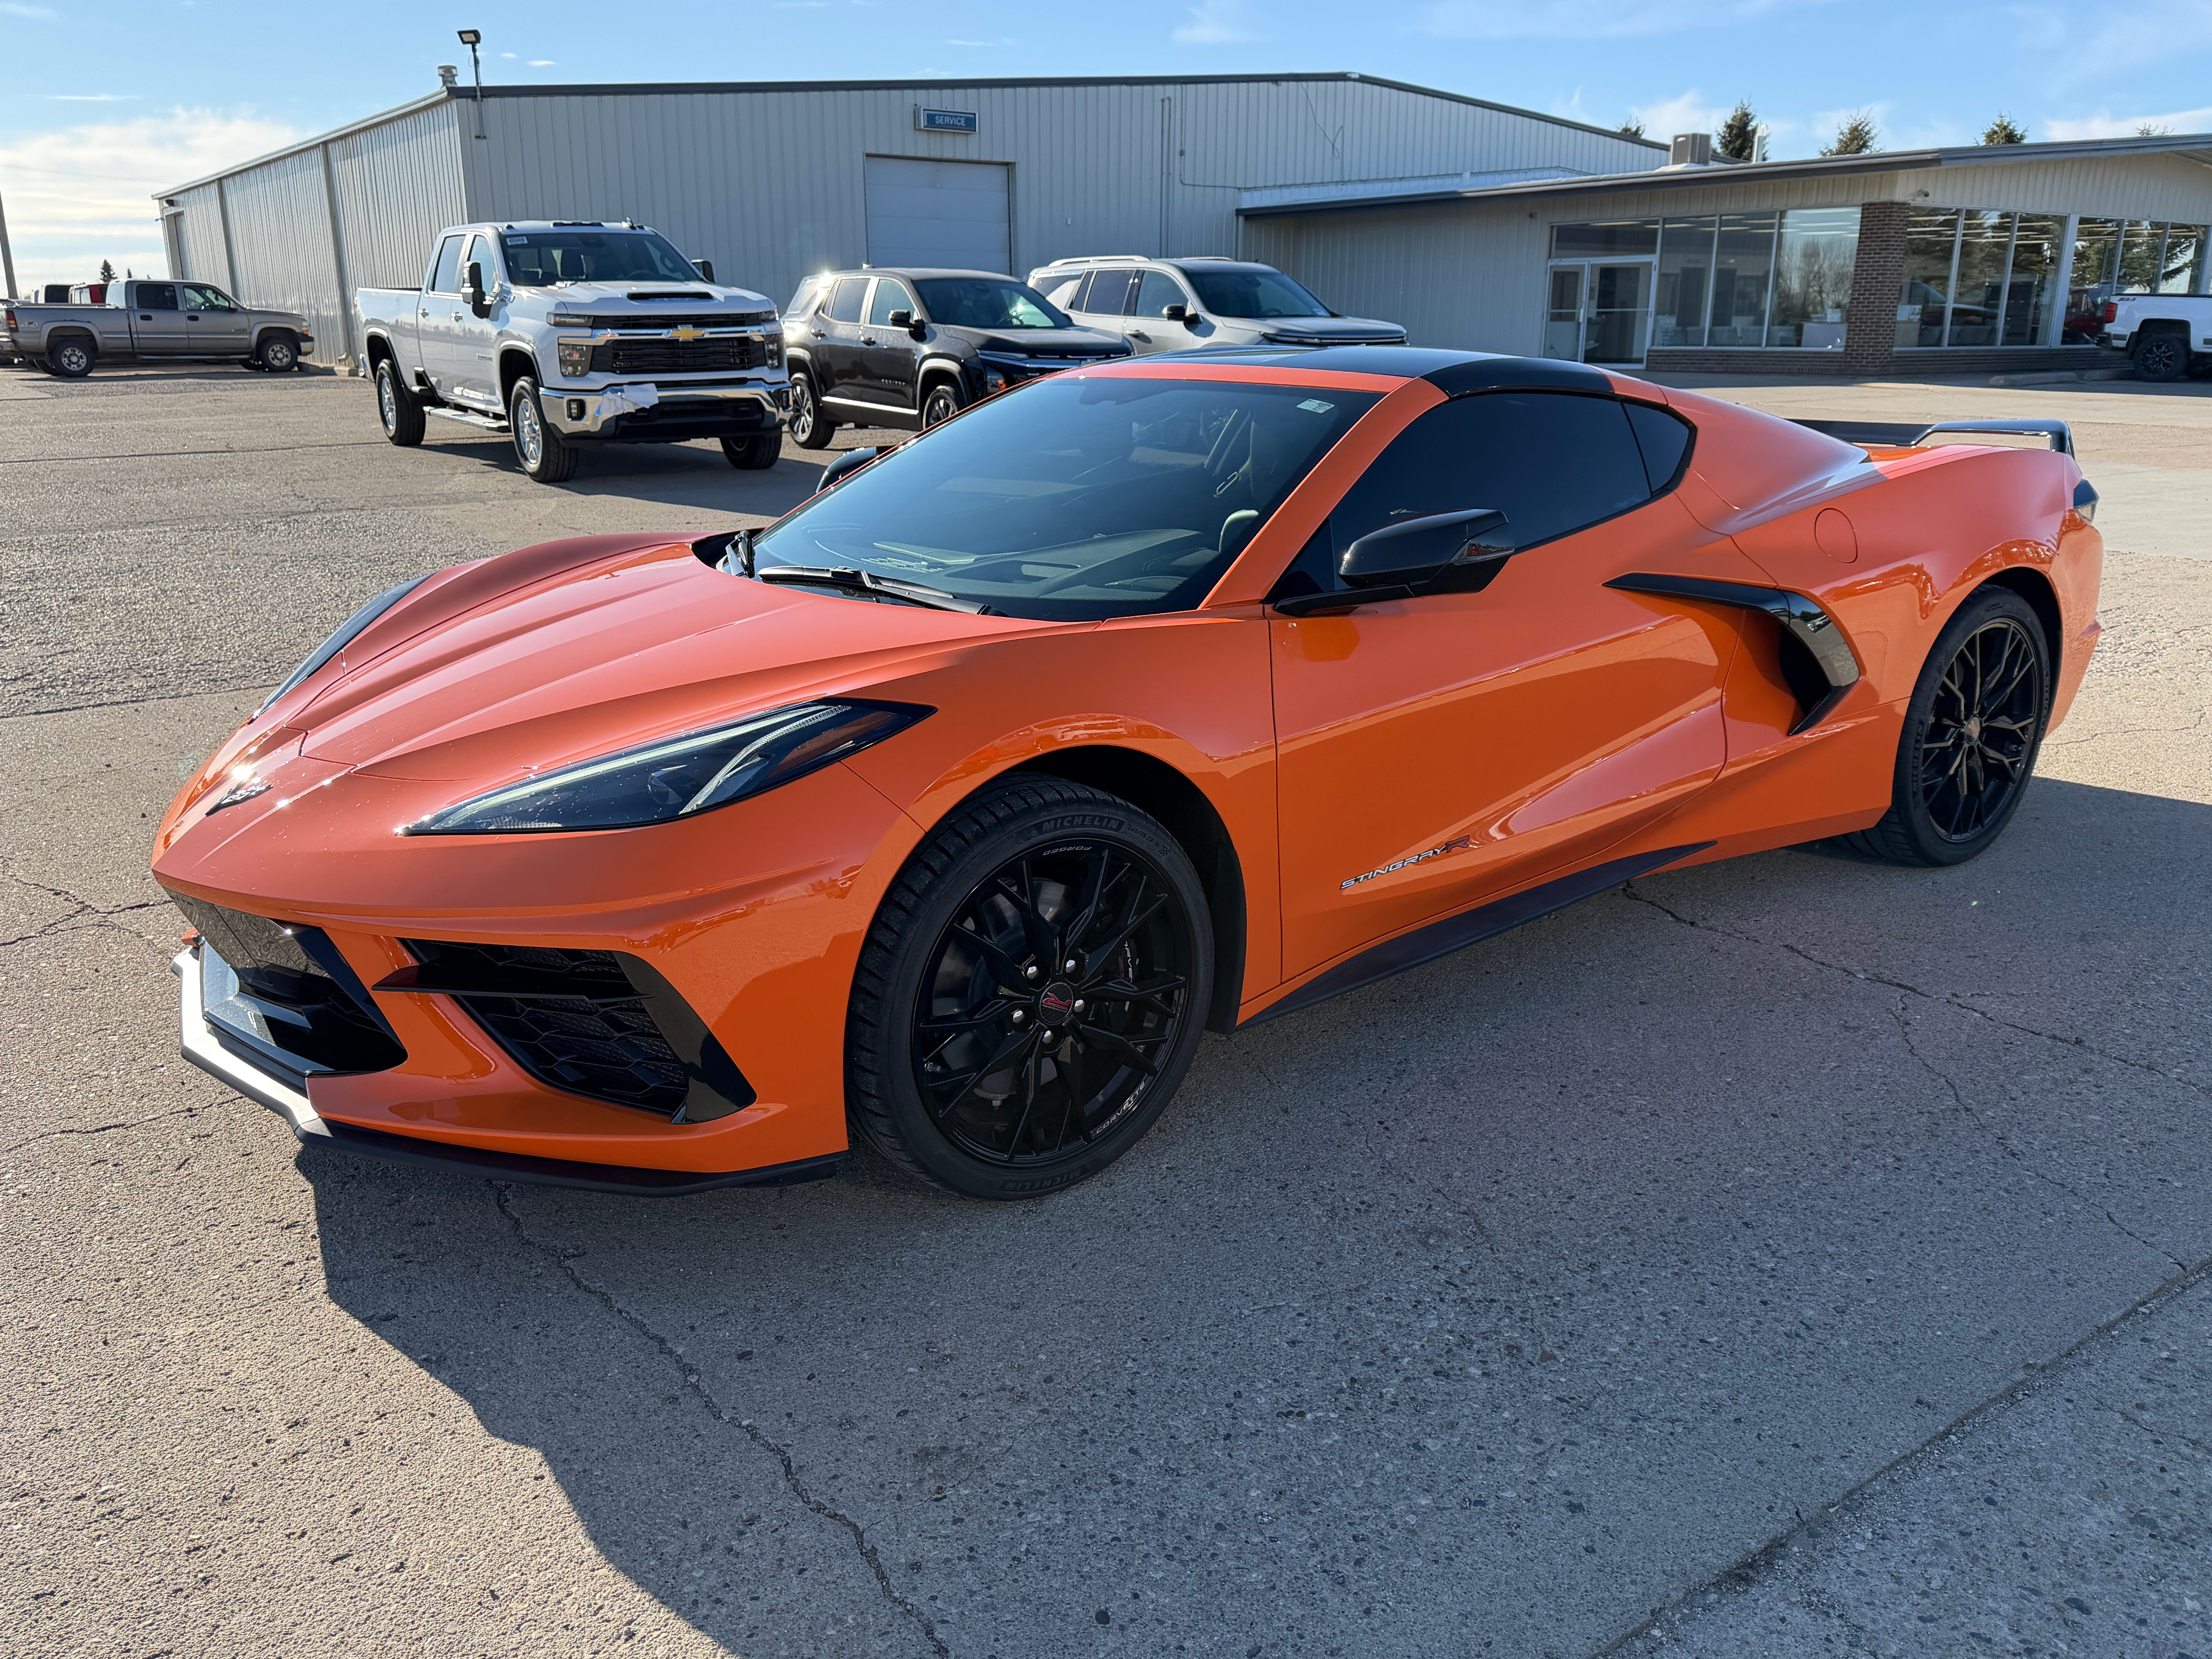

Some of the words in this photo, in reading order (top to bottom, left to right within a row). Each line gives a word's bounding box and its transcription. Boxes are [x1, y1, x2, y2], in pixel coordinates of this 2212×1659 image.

[935, 116, 966, 126] SERVICE
[1042, 816, 1119, 831] MICHELIN
[1043, 846, 1092, 856] FORGED
[1340, 845, 1447, 890] STINGRAY
[1096, 1081, 1146, 1133] CORVETTE
[1005, 1169, 1082, 1190] MICHELIN
